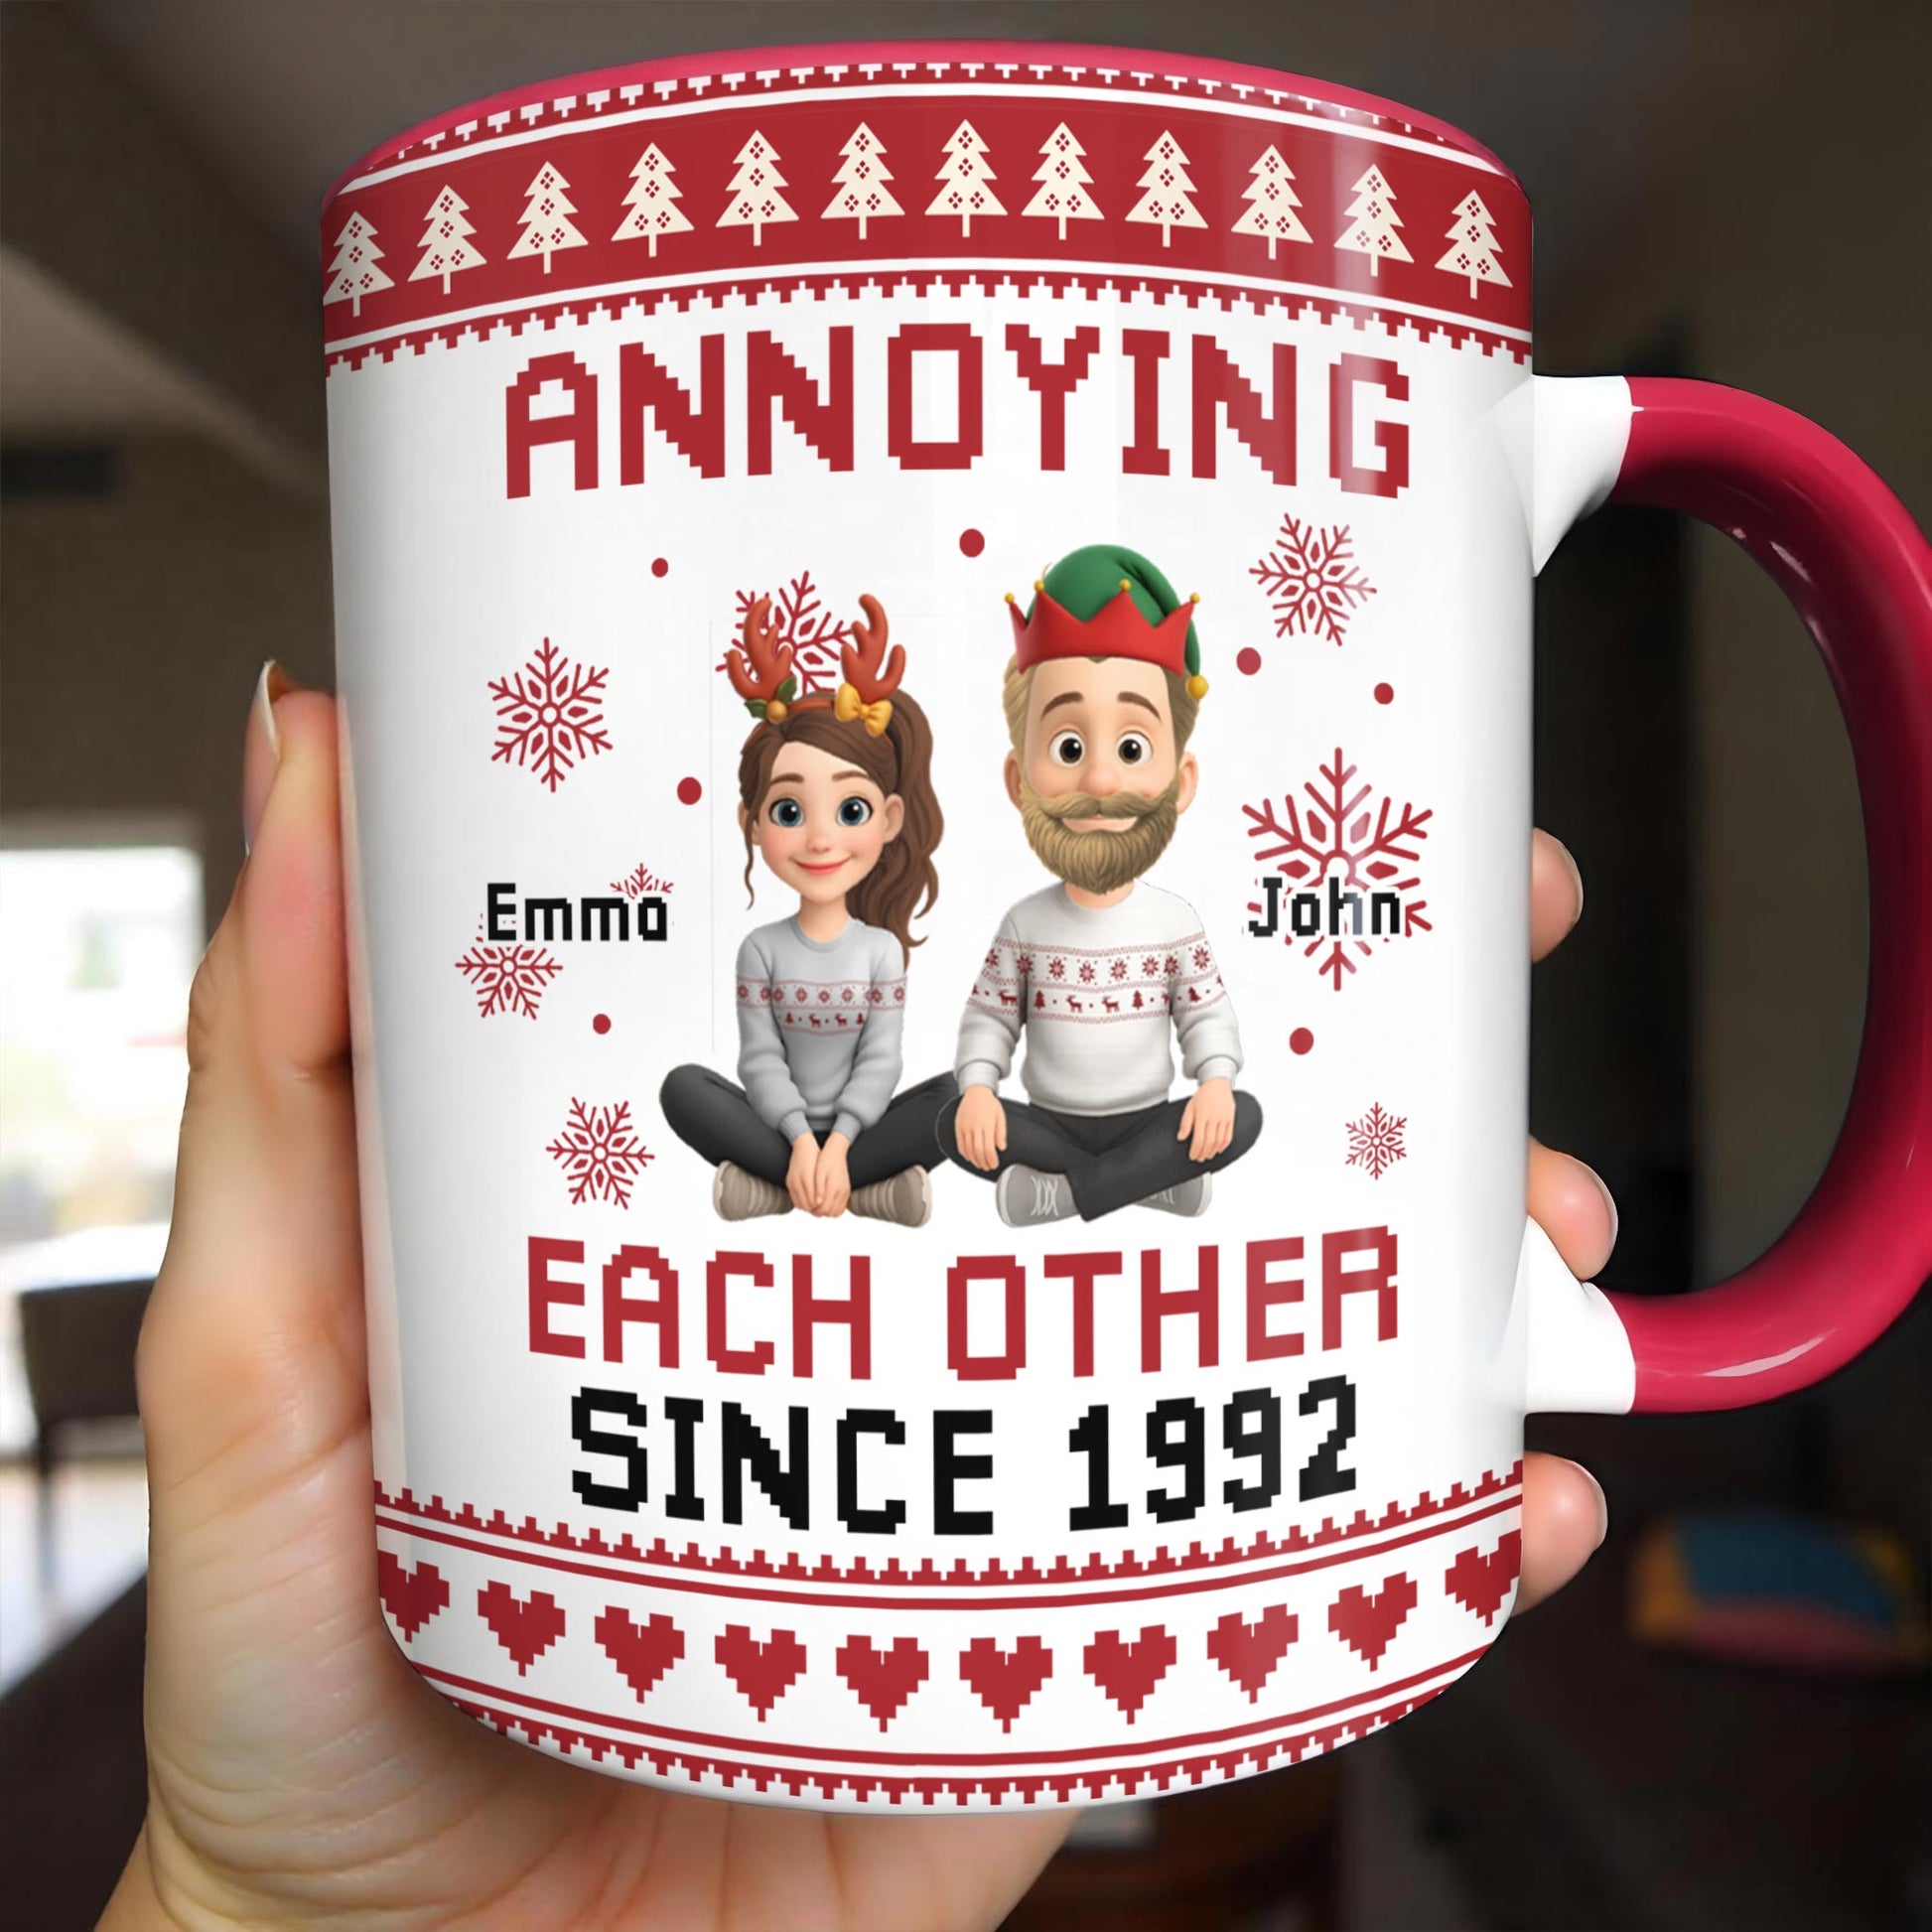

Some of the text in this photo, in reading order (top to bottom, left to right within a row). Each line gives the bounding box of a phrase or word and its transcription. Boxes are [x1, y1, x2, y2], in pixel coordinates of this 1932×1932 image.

[505, 323, 1410, 498] ANNOYING
[487, 883, 667, 941] Emma
[1249, 877, 1401, 937] John
[528, 1225, 1399, 1381] EACH OTHER
[571, 1375, 1357, 1536] SINCE 1992
